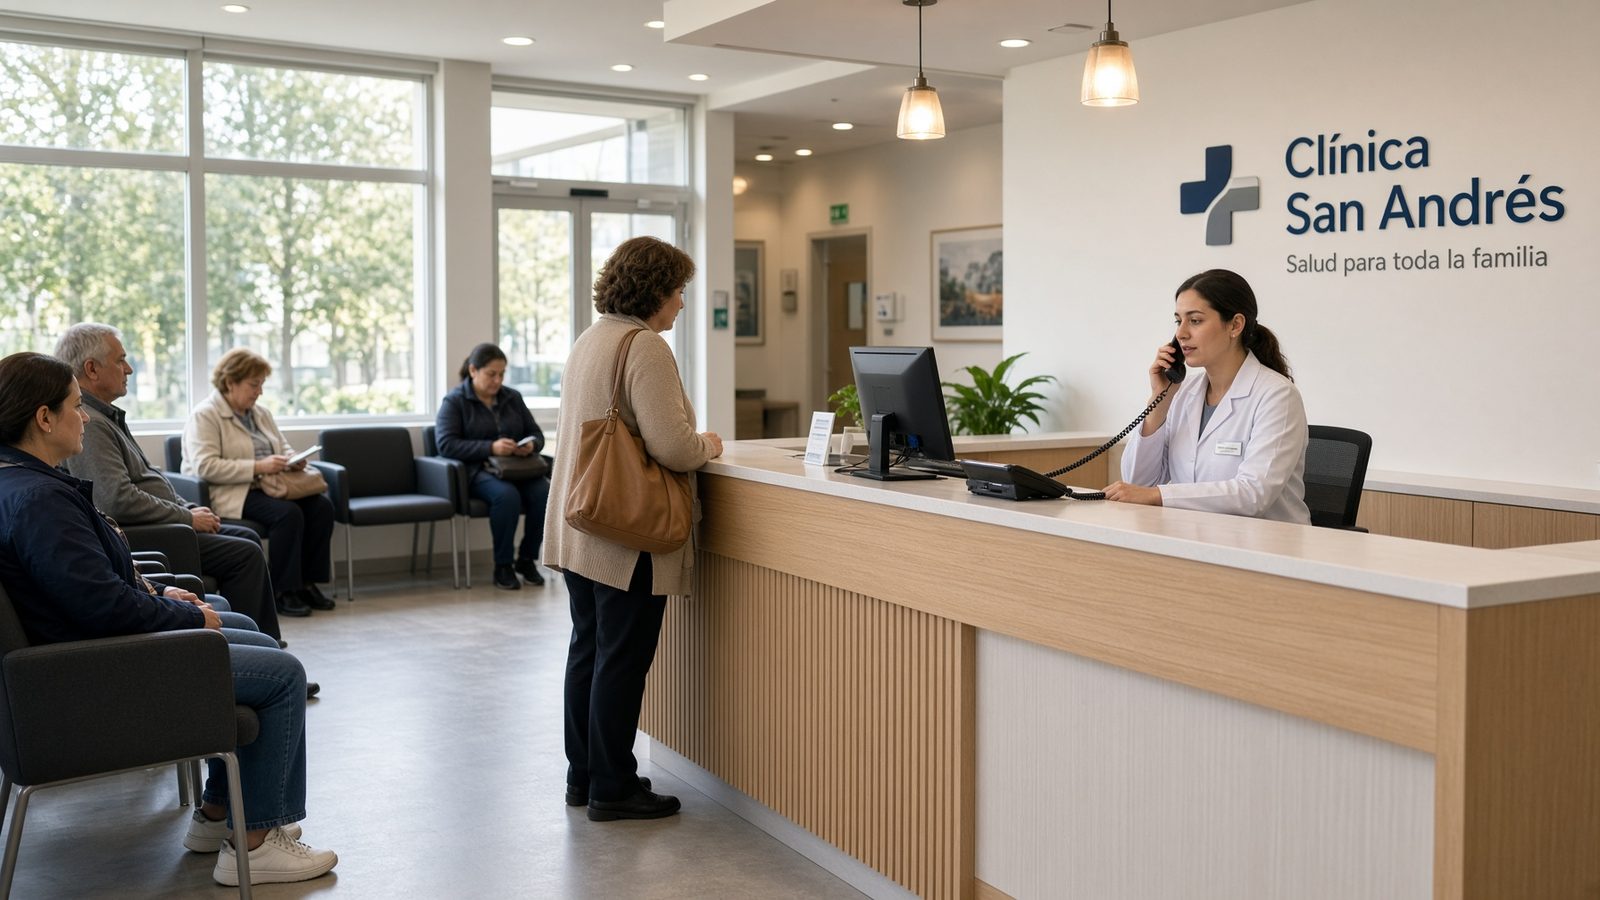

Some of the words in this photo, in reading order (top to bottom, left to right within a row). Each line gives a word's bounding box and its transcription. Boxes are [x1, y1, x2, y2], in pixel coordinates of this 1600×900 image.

[1284, 128, 1430, 179] Clínica
[1285, 191, 1365, 236] San
[1378, 173, 1567, 231] Andrés
[1286, 252, 1337, 274] Salud
[1343, 256, 1387, 278] para
[1392, 249, 1440, 271] toda
[1448, 248, 1465, 270] la
[1471, 245, 1548, 269] familia
